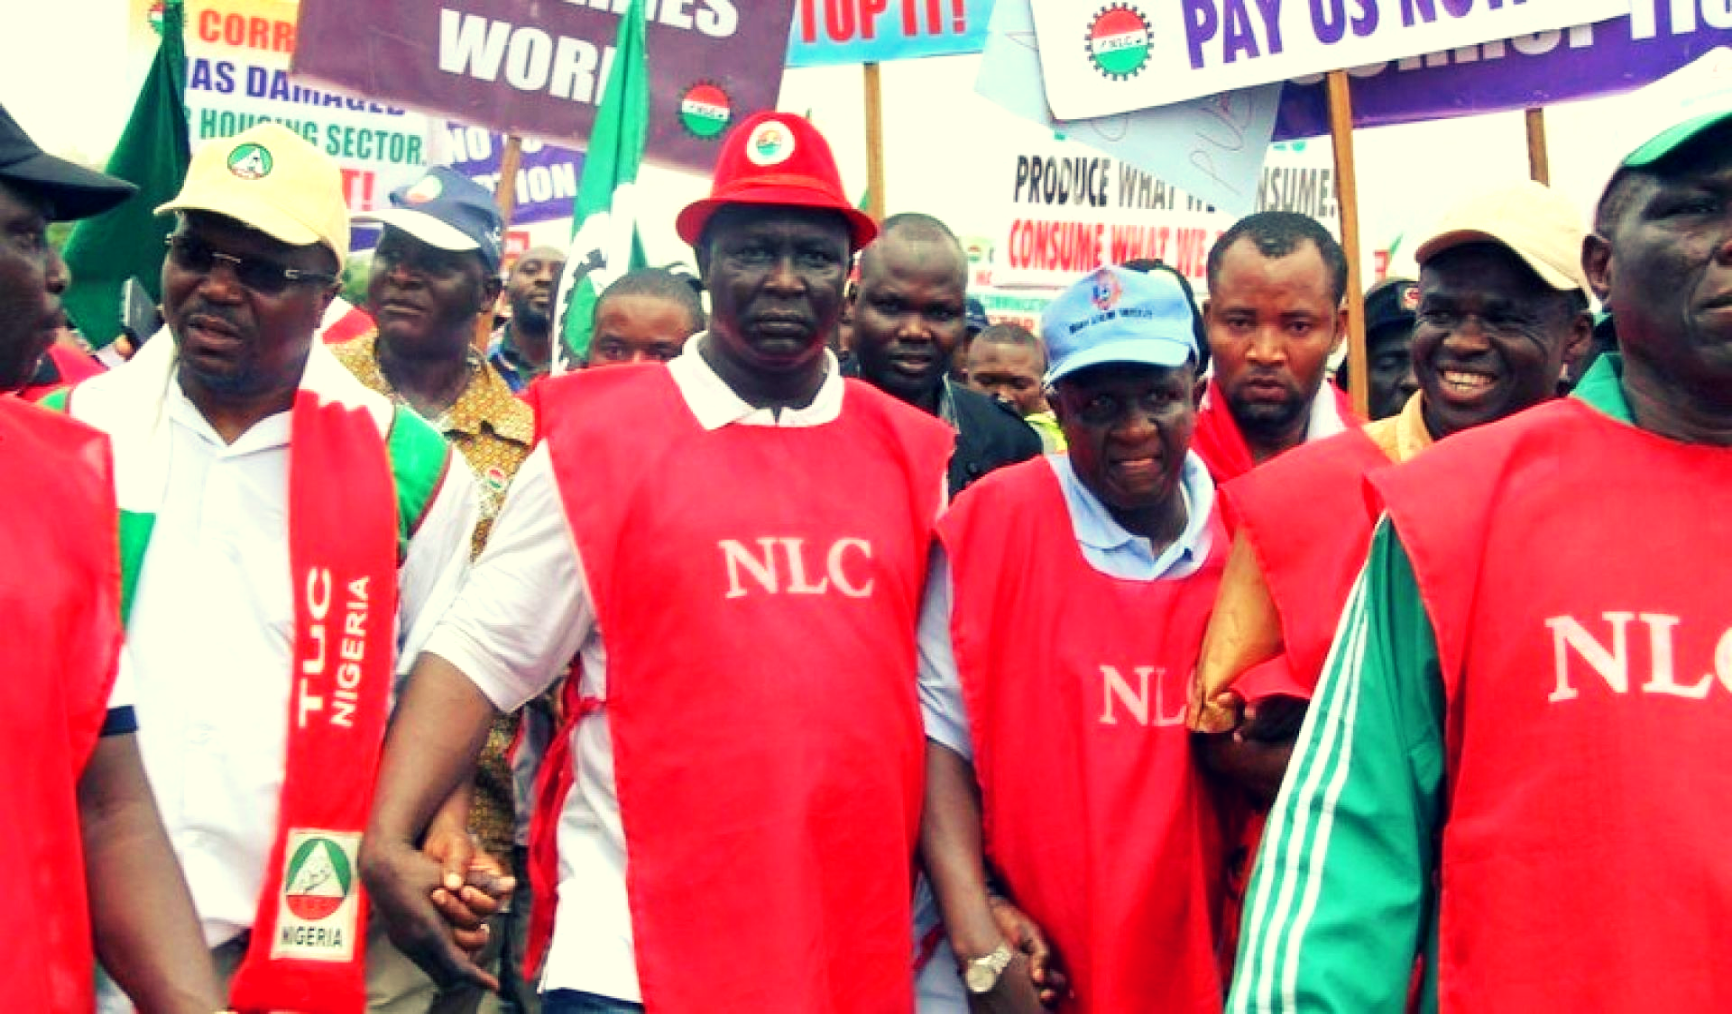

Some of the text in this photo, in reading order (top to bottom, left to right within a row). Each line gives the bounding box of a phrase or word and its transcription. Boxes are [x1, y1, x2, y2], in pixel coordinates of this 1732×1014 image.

[438, 7, 618, 107] WOR
[1180, 0, 1283, 69] PAY
[185, 56, 235, 93] AS
[326, 123, 427, 166] SECTOR.
[449, 127, 491, 163] NO
[1012, 154, 1111, 208] PRODUCE
[1007, 217, 1207, 278] CONSUME WHAT WE
[717, 536, 875, 599] NLC
[298, 565, 332, 730] TUC
[329, 575, 370, 728] NIGERIA
[1099, 664, 1195, 727] NL
[281, 925, 343, 948] NIGERIA
